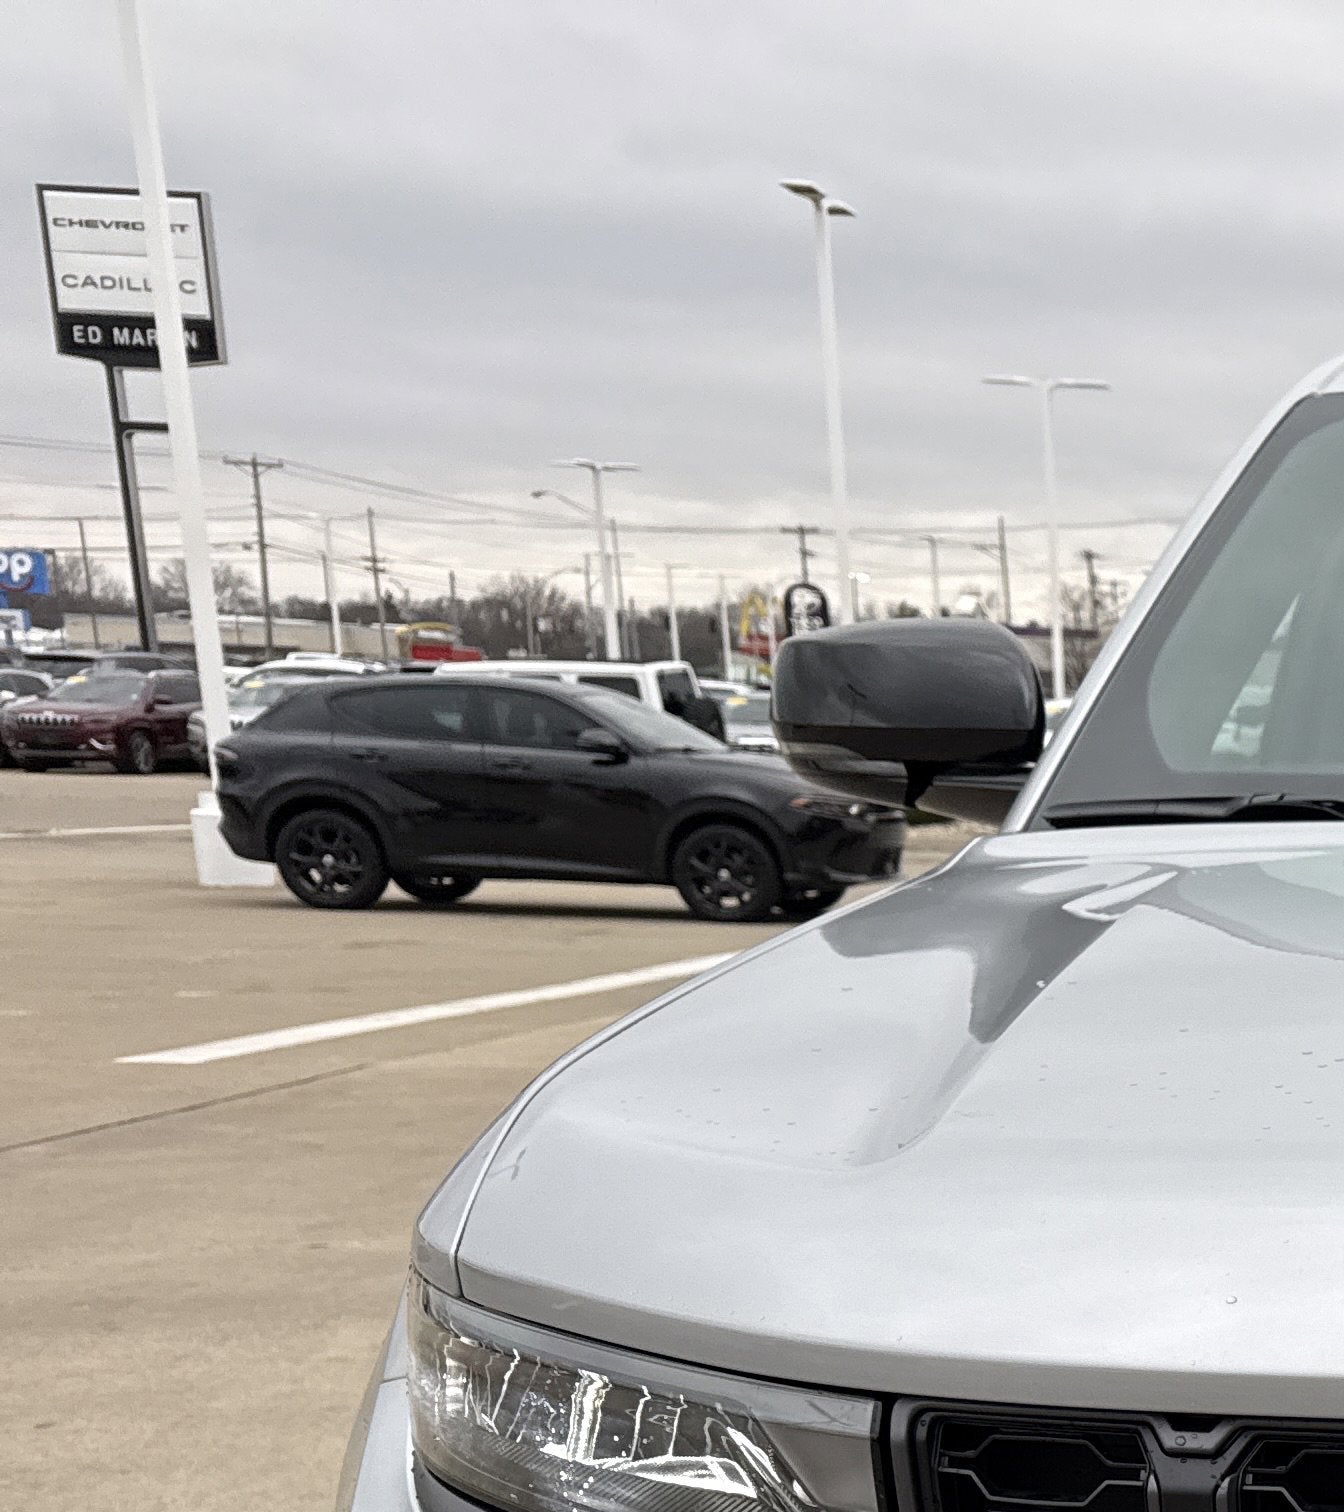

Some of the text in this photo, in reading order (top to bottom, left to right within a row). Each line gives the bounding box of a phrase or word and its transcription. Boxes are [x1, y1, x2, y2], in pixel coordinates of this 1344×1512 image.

[52, 217, 190, 233] CHEVROT
[61, 274, 197, 294] CADILLC
[72, 325, 198, 349] ED MARN
